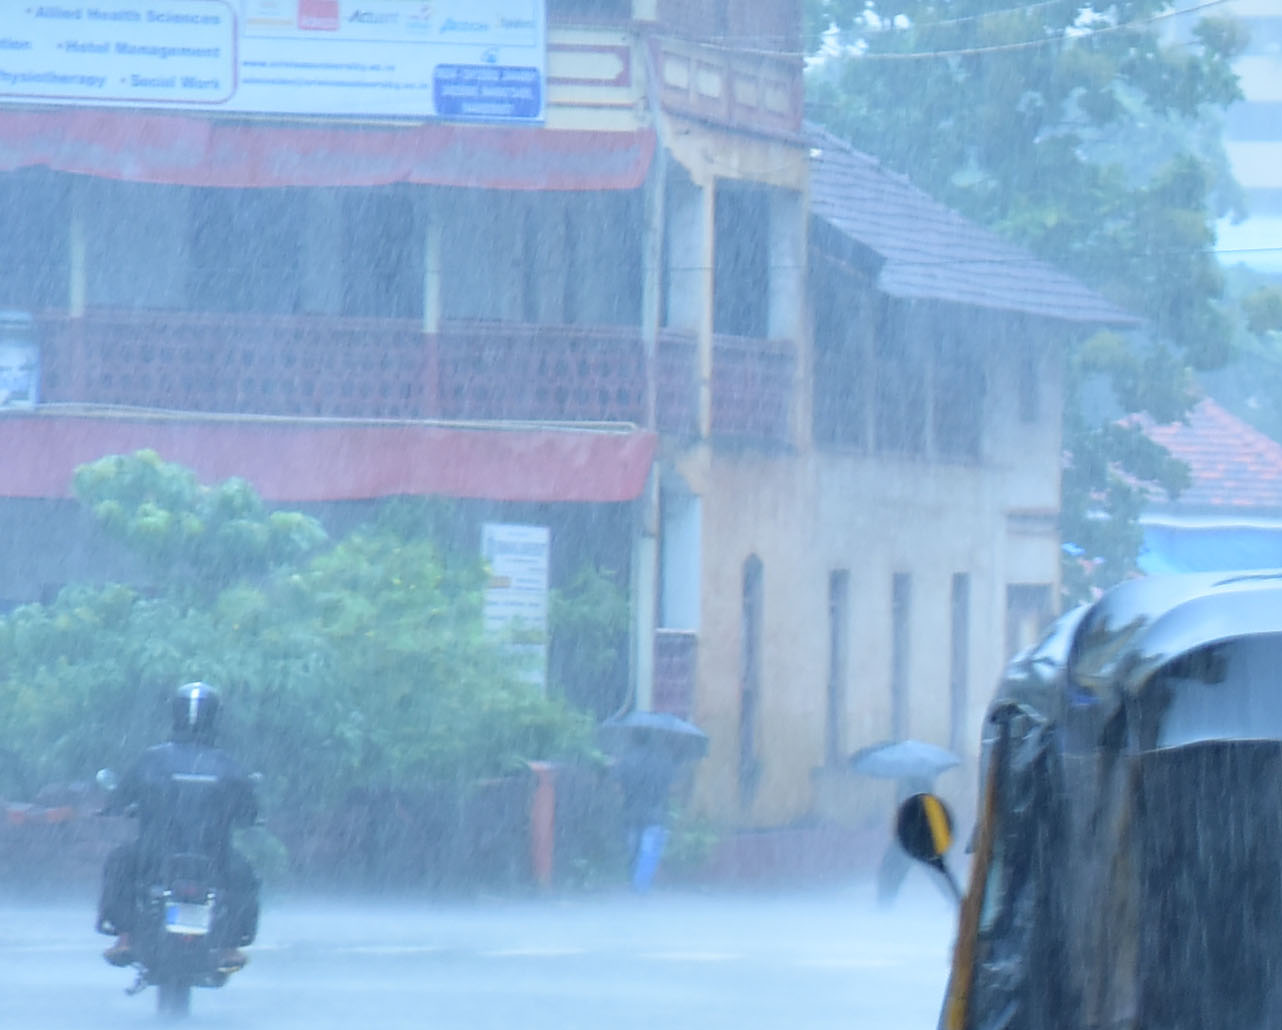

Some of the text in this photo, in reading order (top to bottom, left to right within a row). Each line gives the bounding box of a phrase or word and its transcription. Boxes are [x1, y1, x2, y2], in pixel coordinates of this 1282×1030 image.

[87, 8, 141, 21] Health
[147, 10, 222, 25] Sciences
[115, 41, 221, 59] Management
